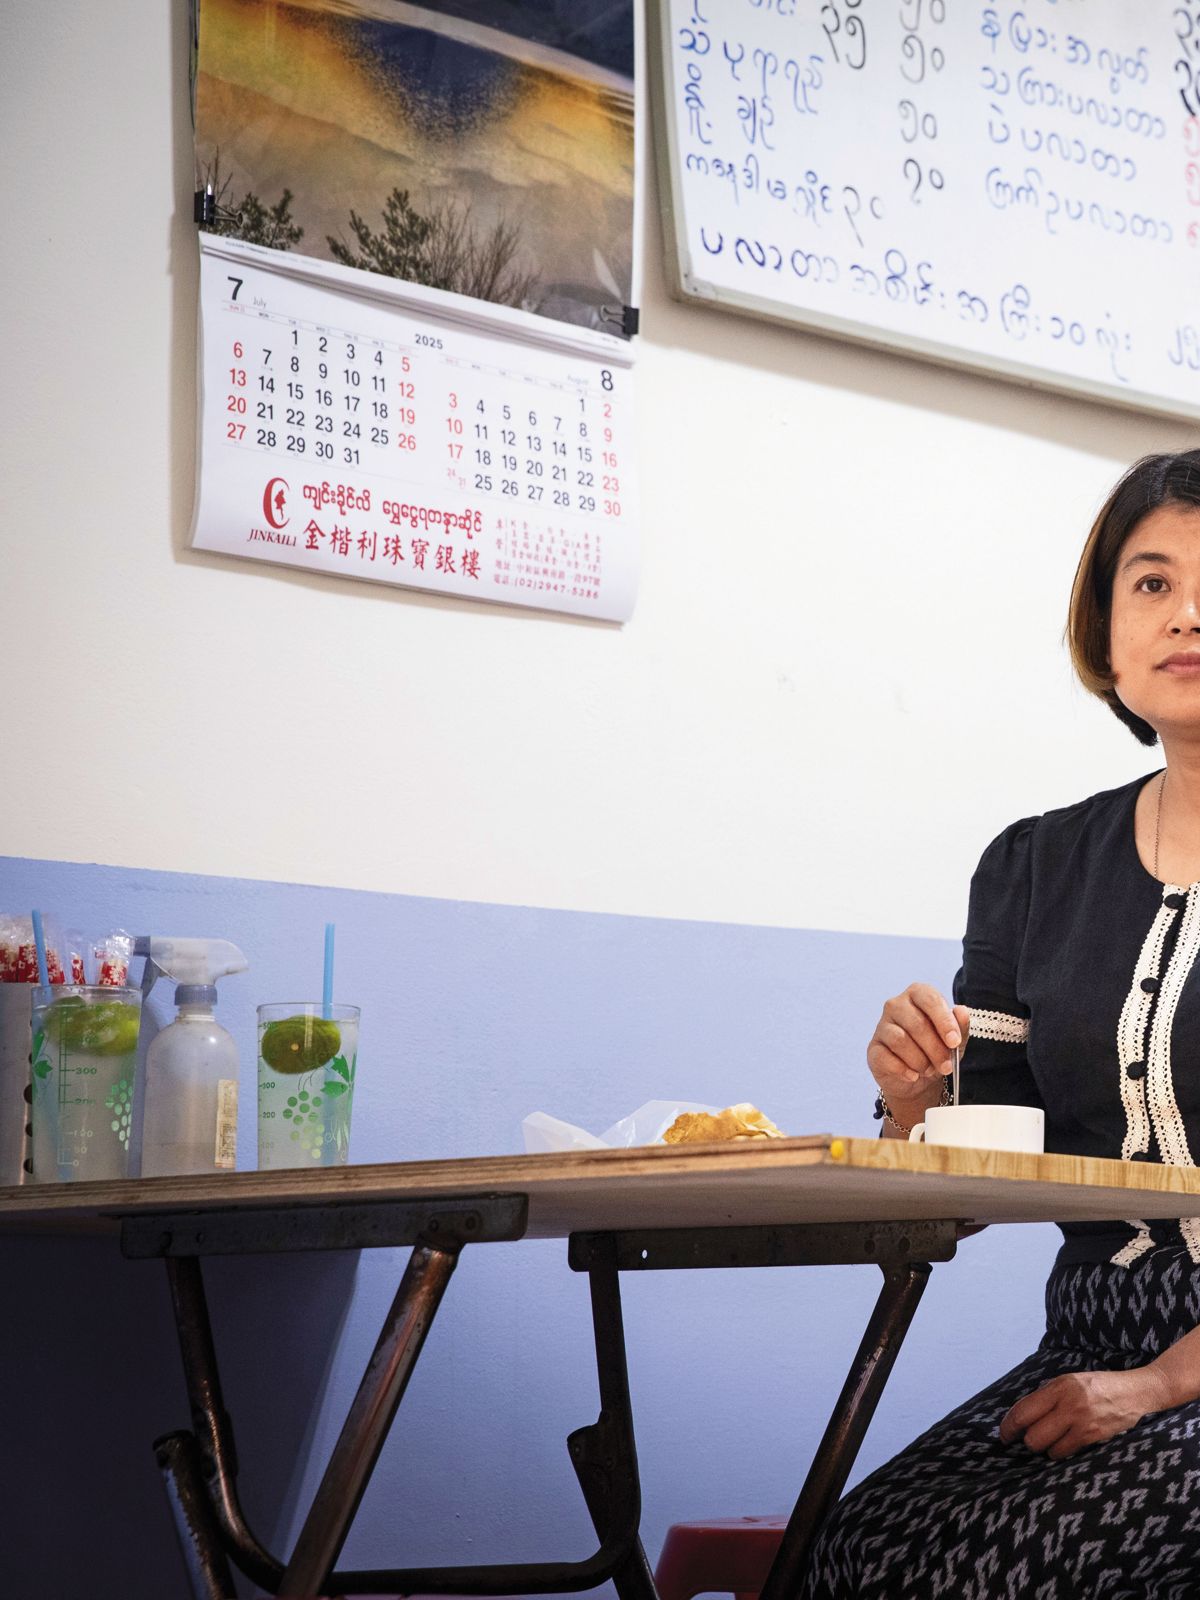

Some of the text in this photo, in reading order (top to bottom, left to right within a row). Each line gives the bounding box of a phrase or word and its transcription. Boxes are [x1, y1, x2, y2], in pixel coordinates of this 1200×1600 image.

[900, 35, 944, 83] ၅၀
[899, 100, 938, 142] ၅၀
[227, 276, 243, 301] 7
[291, 329, 297, 345] 1
[318, 335, 327, 353] 2
[346, 342, 355, 359] 3
[373, 349, 383, 366] 4
[401, 356, 410, 372] 5
[415, 333, 444, 350] 2025
[232, 341, 414, 399] 6 7 8 9 10 11 12
[601, 369, 614, 391] 8
[229, 367, 415, 424] 13 14 15 16 17 18 19
[448, 392, 612, 442] 3 4 5 6 7 8 9
[579, 397, 611, 418] 1 2
[226, 394, 416, 450] 20 21 22 23 24 25 26
[226, 421, 359, 464] 27 28 29 30 31
[445, 417, 617, 467] 10 11 12 13 14 15 16
[447, 442, 619, 492] 17 18 19 20 21 22 23
[474, 473, 492, 491] 25
[501, 478, 518, 496] 26
[527, 484, 544, 501] 27
[552, 489, 570, 506] 28
[578, 494, 595, 511] 29
[604, 499, 620, 516] 30
[247, 528, 297, 547] JINKAILI
[301, 518, 483, 580] 金楷利珠寶銀樓
[76, 1067, 97, 1075] 300
